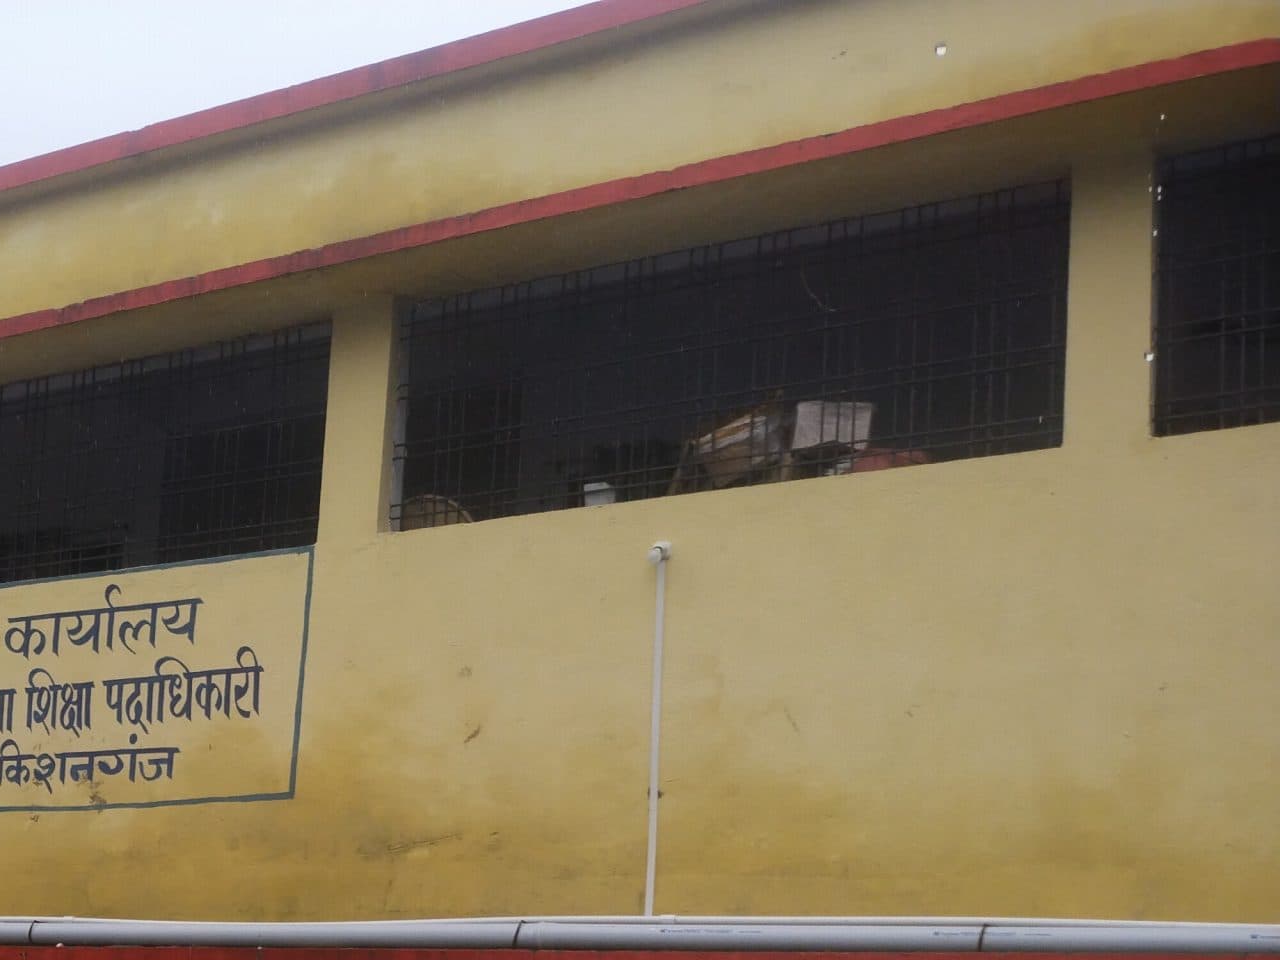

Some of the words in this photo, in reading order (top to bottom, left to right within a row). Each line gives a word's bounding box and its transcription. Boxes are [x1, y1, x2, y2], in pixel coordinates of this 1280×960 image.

[5, 584, 203, 658] कार्यालय
[25, 669, 95, 738] शिक्षा
[103, 646, 264, 733] पदाधिकारी
